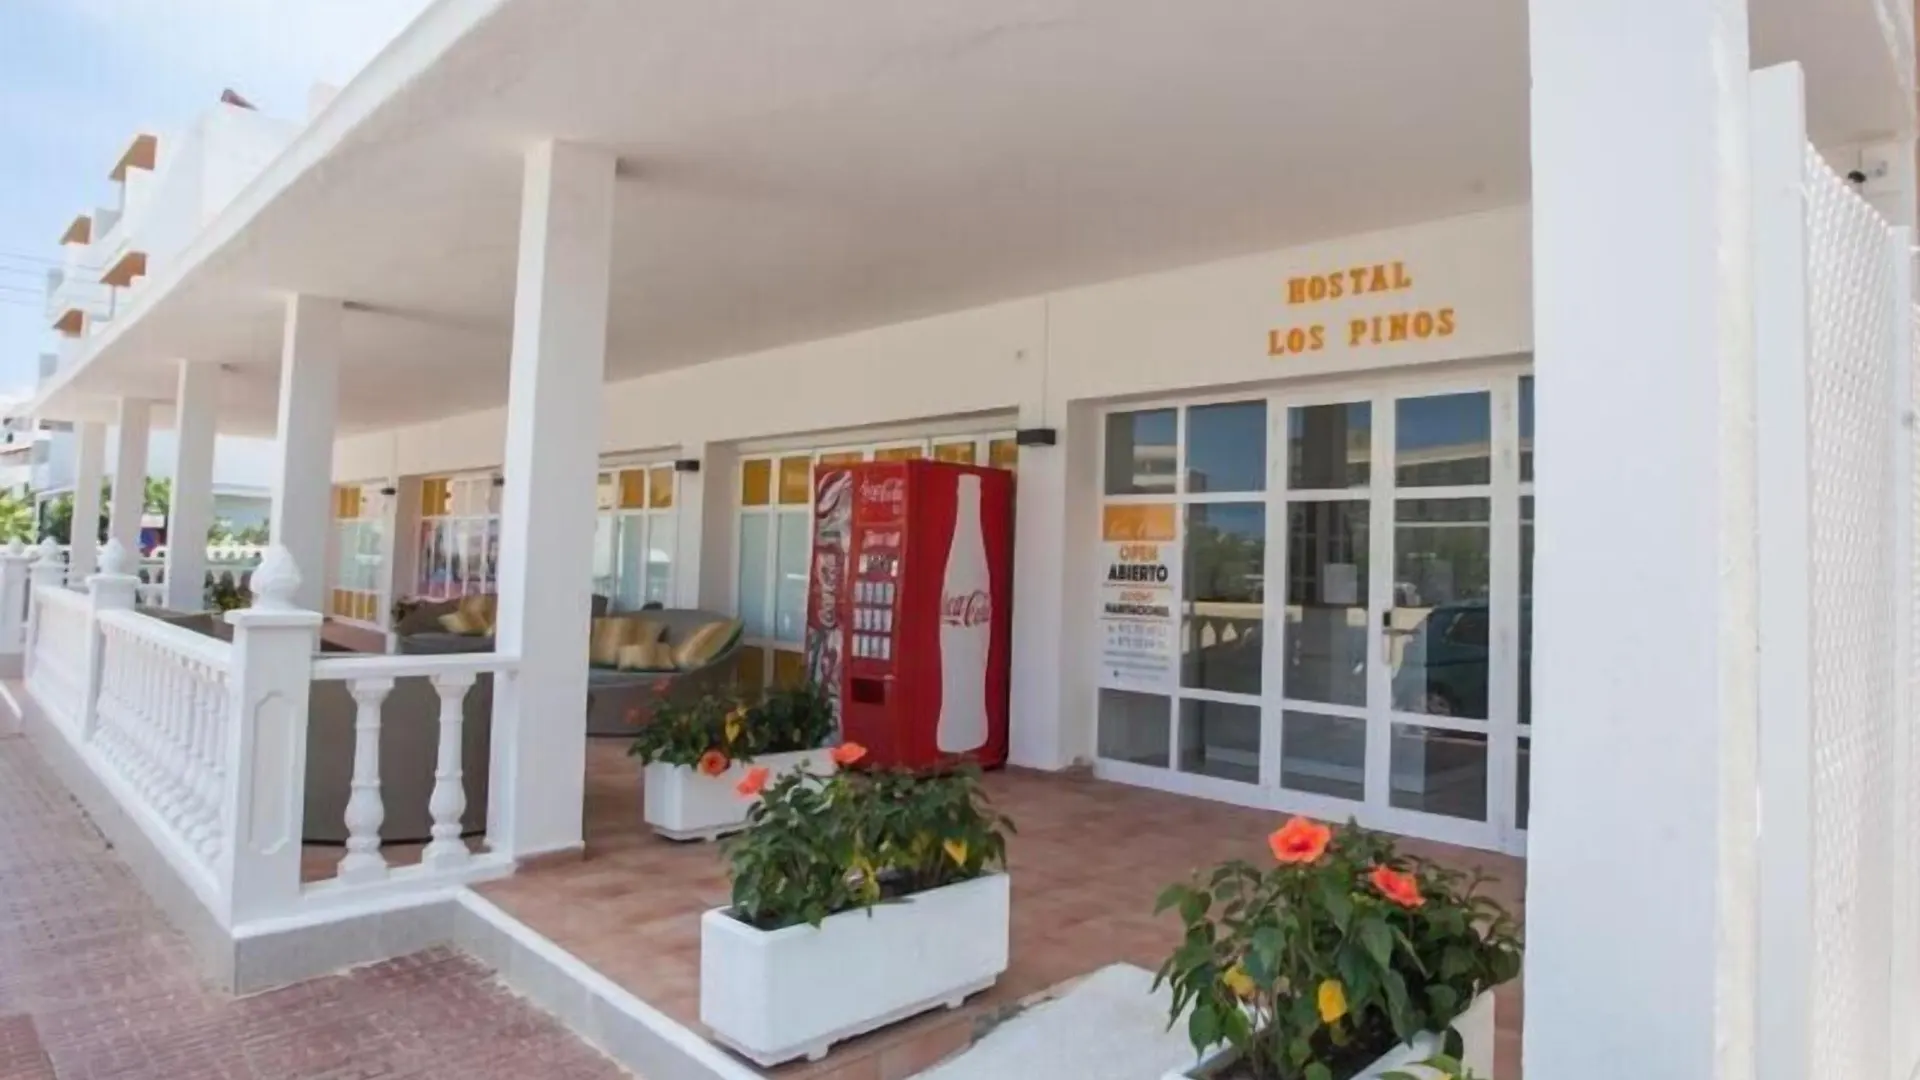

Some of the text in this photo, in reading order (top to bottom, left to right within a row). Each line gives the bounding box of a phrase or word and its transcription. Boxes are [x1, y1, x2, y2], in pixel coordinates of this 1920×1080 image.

[1287, 261, 1412, 304] HOSTAL
[1267, 307, 1455, 356] LOS PINOS
[1119, 544, 1158, 562] OPEN
[1108, 563, 1168, 583] ABIERTO
